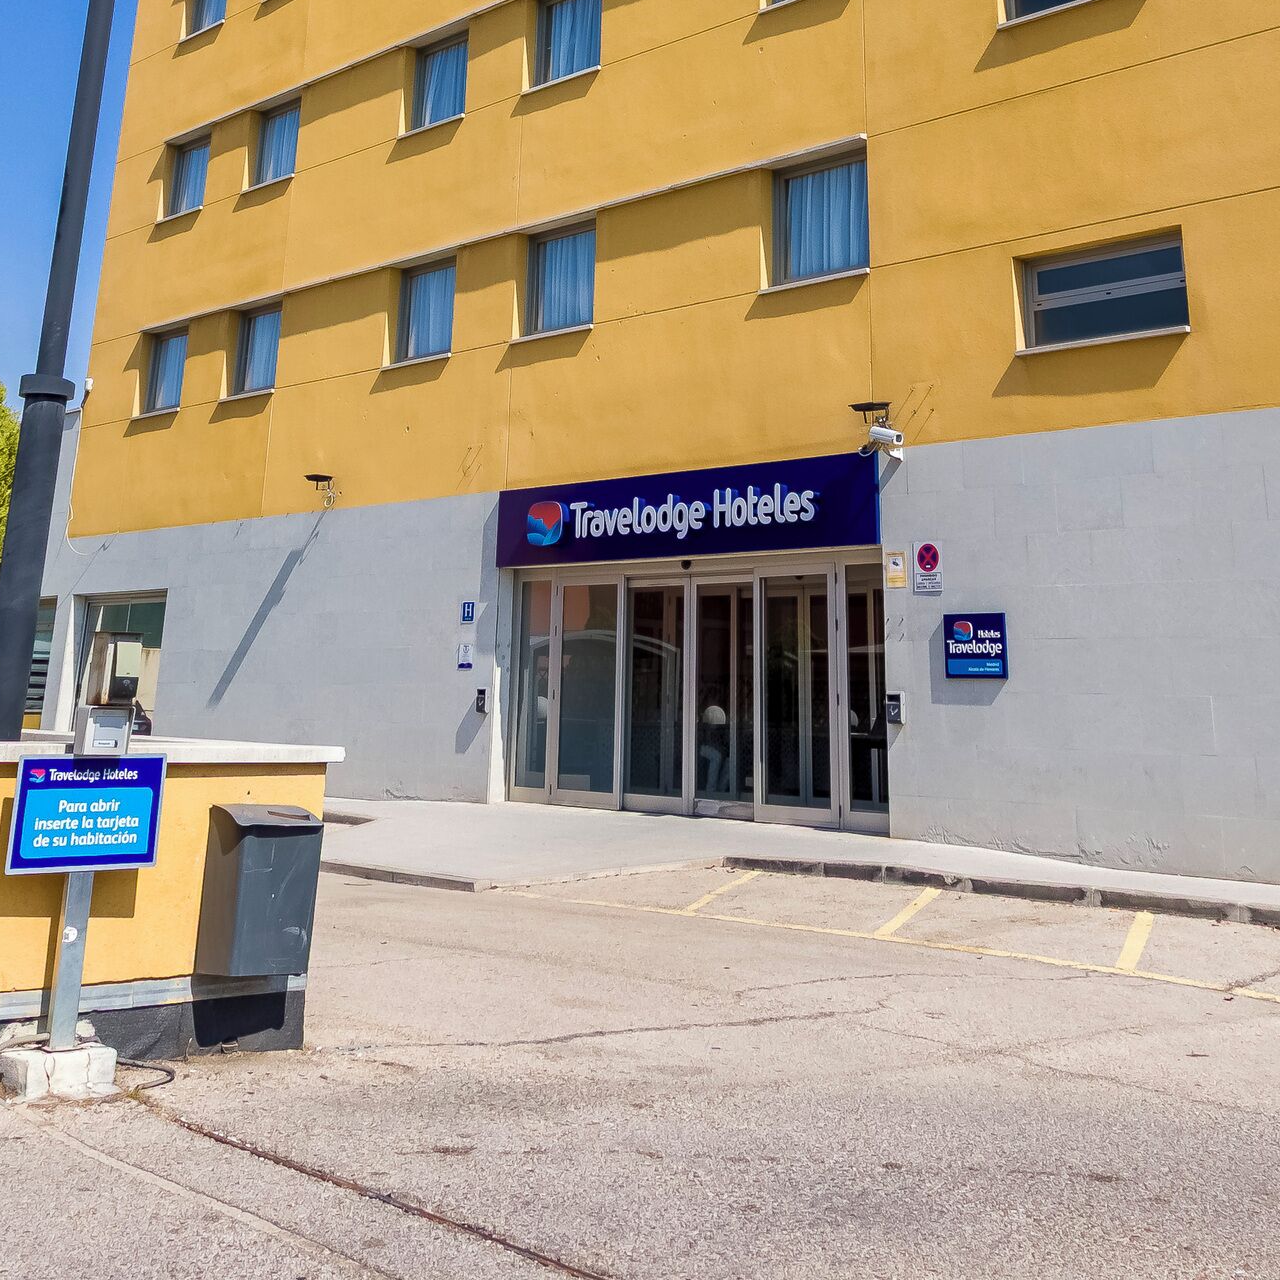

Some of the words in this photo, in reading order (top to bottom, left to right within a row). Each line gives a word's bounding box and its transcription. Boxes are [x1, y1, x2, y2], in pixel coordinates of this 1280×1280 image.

[570, 493, 706, 539] Travelodge
[713, 482, 815, 528] Hoteles
[464, 604, 472, 616] H
[977, 629, 1001, 638] Hoteles
[946, 640, 1003, 657] Travelodge
[49, 768, 101, 783] Travelodge
[102, 767, 139, 780] Hoteles
[58, 799, 88, 813] Para
[90, 798, 121, 812] abrir
[34, 817, 79, 831] inserte
[81, 815, 94, 829] la
[96, 815, 140, 832] tarjeta
[33, 833, 50, 848] de
[52, 836, 68, 847] su
[70, 830, 138, 846] habitación
